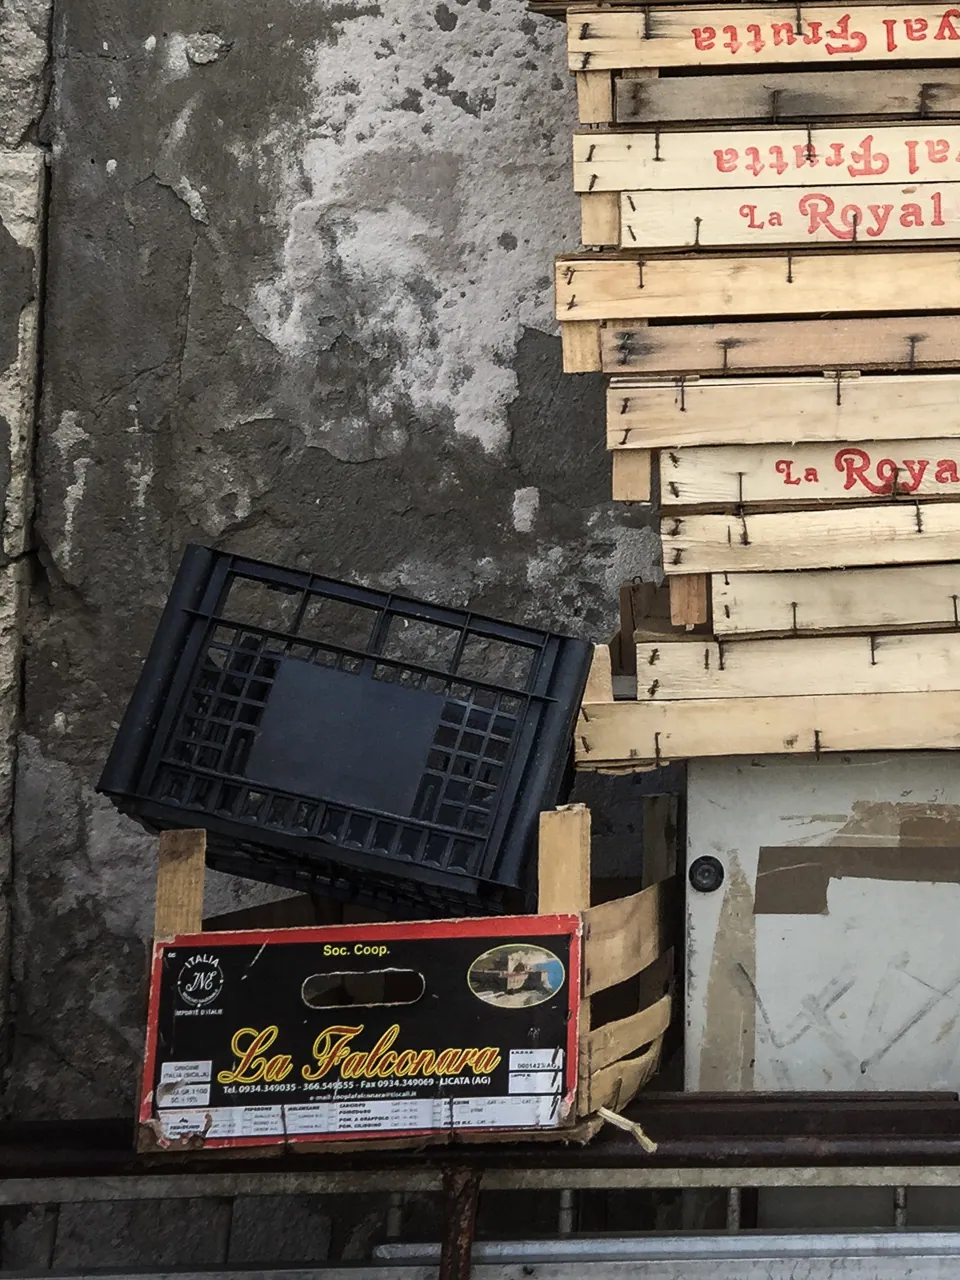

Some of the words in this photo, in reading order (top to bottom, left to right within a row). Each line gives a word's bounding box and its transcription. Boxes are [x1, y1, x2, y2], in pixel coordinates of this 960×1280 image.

[691, 13, 869, 57] Frutta
[714, 135, 891, 179] Frutta
[740, 204, 784, 231] La
[798, 192, 946, 242] Royal
[775, 459, 820, 487] La
[184, 953, 220, 969] ITALIA
[323, 943, 351, 957] Soc.
[353, 943, 391, 958] Coop.
[217, 1024, 294, 1084] La
[301, 1023, 502, 1081] Falconara
[223, 1085, 238, 1094] Tel.
[360, 1080, 376, 1089] Fax
[440, 1076, 470, 1087] LICATA
[471, 1075, 492, 1086] (AG)
